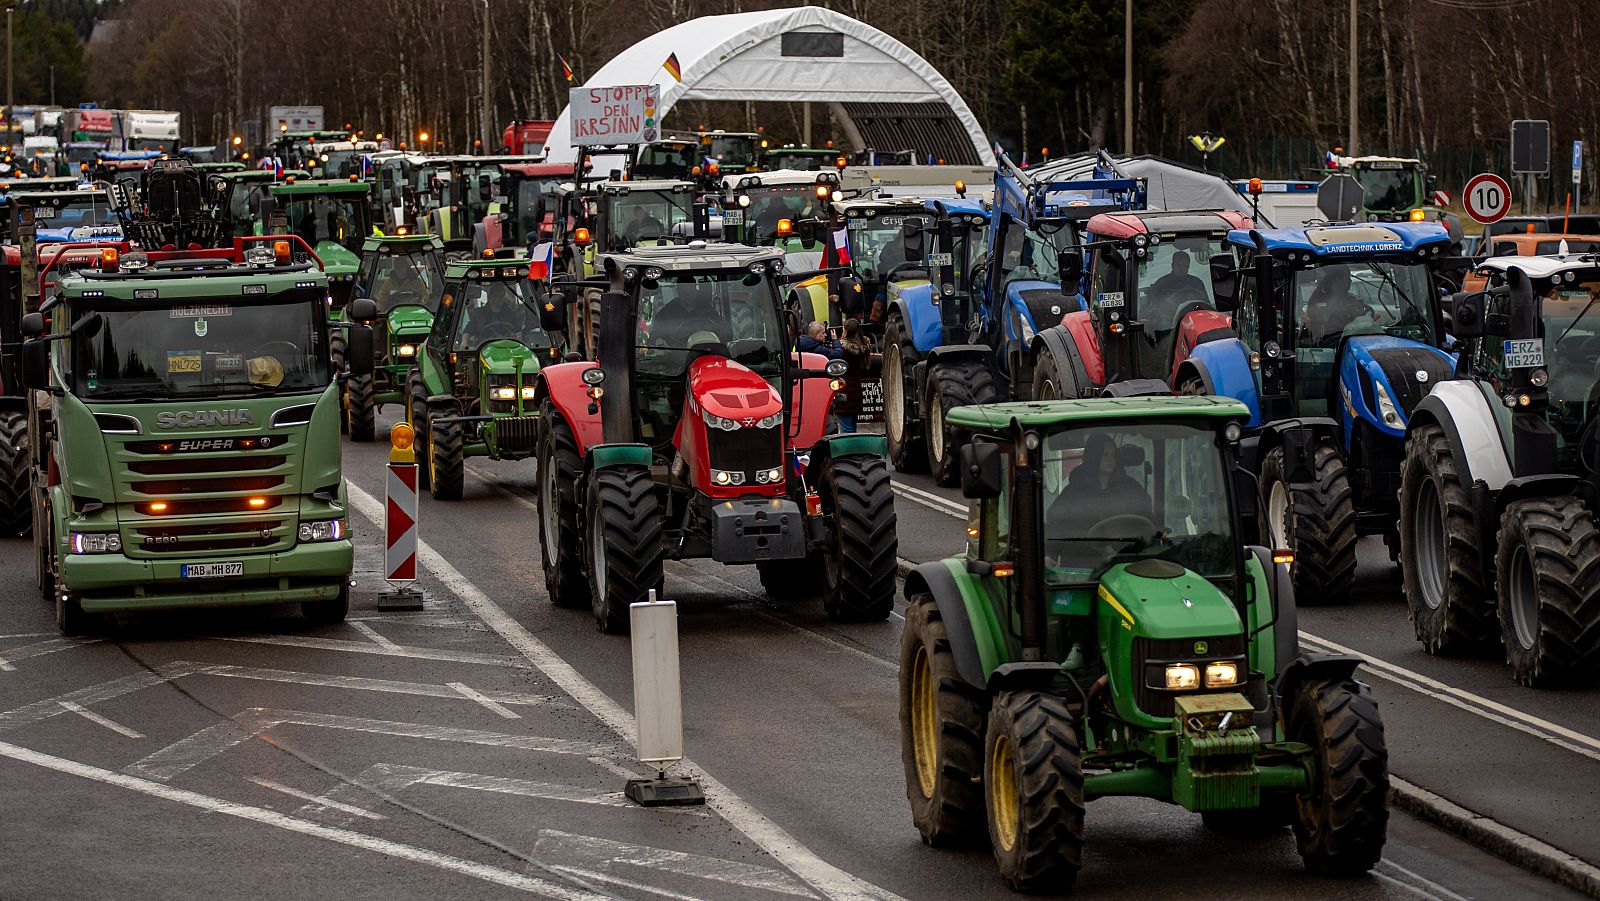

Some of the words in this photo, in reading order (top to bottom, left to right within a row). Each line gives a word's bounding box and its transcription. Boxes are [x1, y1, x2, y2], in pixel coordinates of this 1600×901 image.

[590, 86, 650, 103] STOPPT
[604, 104, 629, 117] DEN
[575, 115, 640, 137] IRRSINN
[1574, 144, 1580, 165] P
[1476, 187, 1500, 210] 10
[1326, 245, 1374, 253] LANDTECHNIK
[1375, 243, 1403, 251] LORENZ
[171, 304, 229, 316] HOLZKNECHT
[1511, 341, 1535, 354] ERZ
[1507, 355, 1521, 367] WG
[1522, 354, 1542, 366] 229
[157, 408, 255, 429] SCANIA
[179, 439, 234, 451] SUPER
[146, 537, 154, 545] R
[187, 565, 205, 577] MAB
[211, 564, 224, 575] MH
[225, 563, 242, 574] 877
